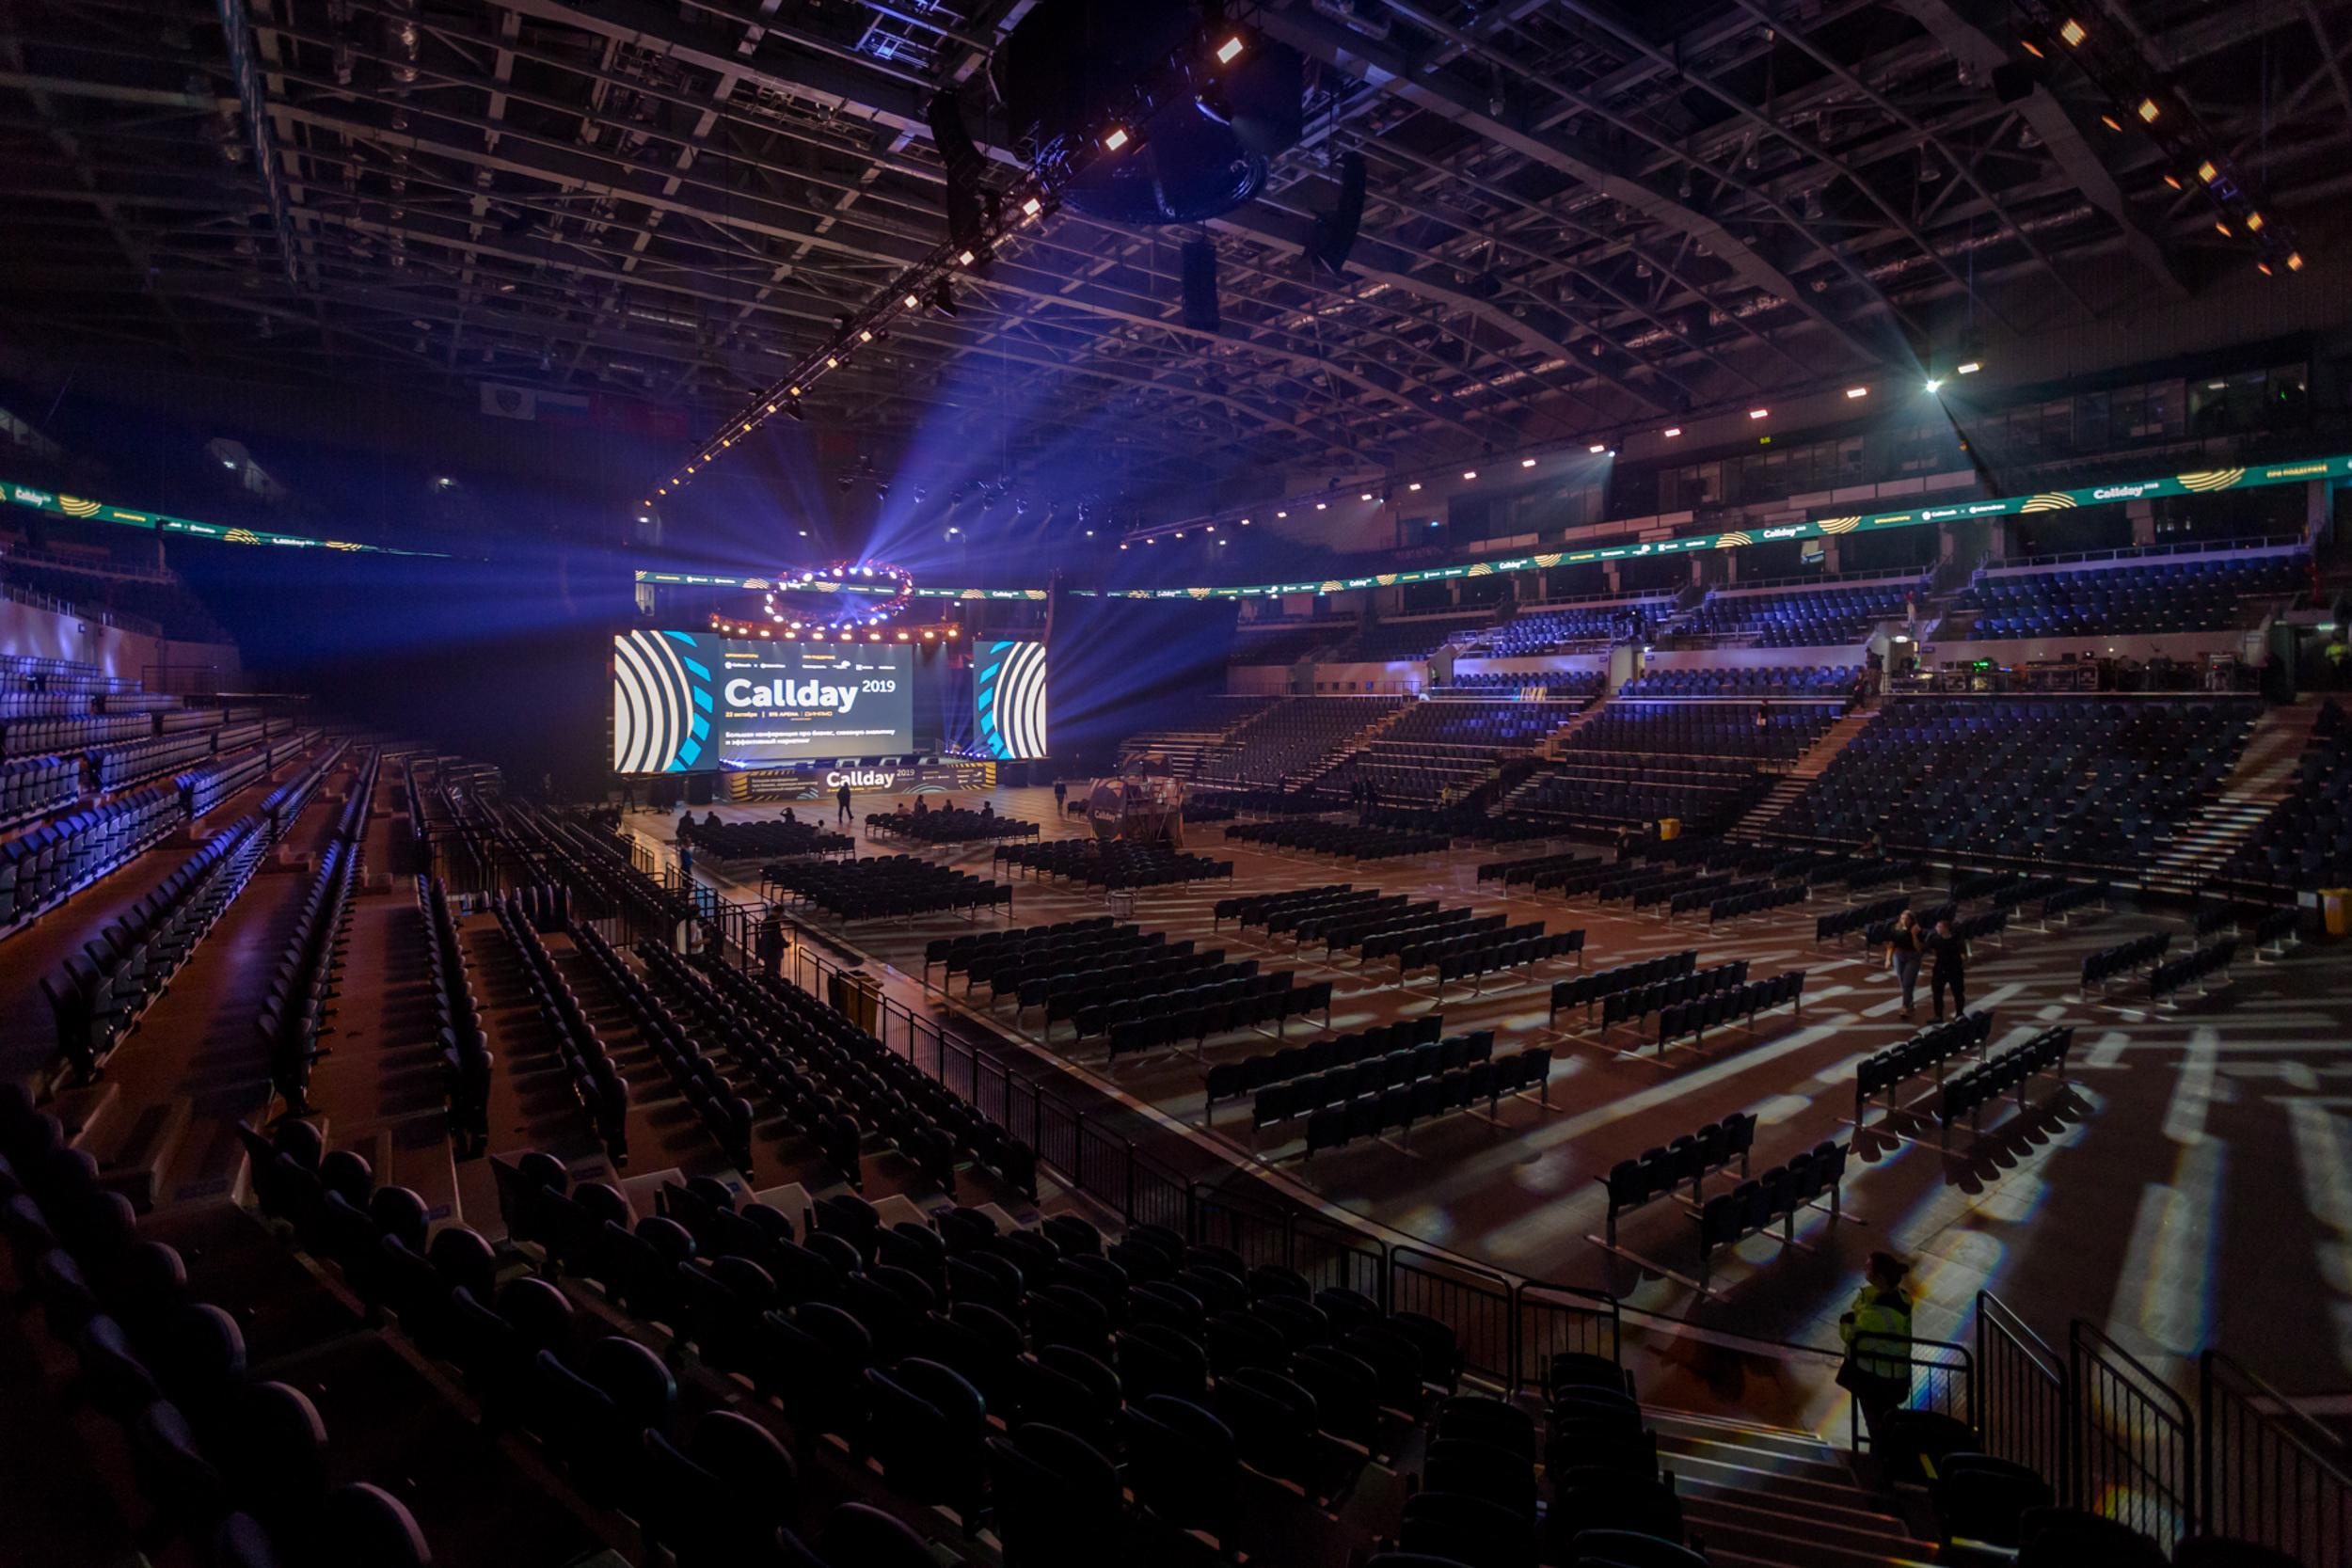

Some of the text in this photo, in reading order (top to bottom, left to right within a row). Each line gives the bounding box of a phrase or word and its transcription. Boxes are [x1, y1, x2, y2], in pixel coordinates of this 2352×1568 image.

[15, 487, 43, 507] Callday
[2094, 486, 2143, 499] Callday
[1763, 528, 1797, 539] Callday
[724, 678, 897, 713] Callday 2019
[826, 770, 895, 788] Callday
[897, 768, 915, 777] 2019
